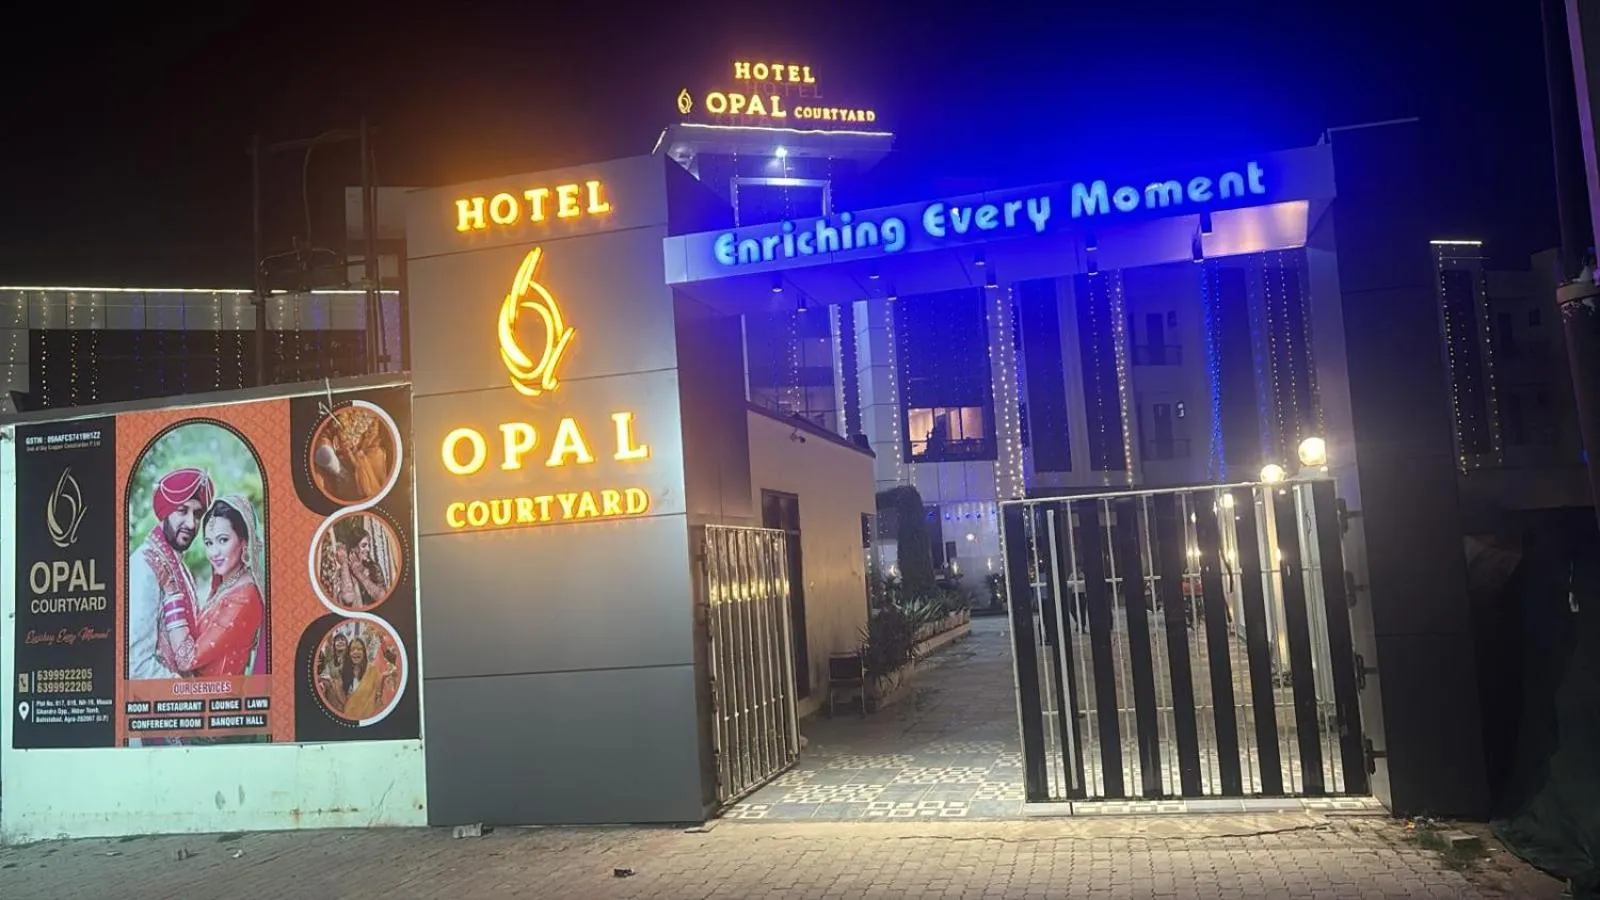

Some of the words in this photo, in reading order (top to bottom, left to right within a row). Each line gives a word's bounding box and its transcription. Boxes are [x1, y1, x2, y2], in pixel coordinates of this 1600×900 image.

[734, 62, 815, 83] HOTEL
[706, 92, 786, 118] OPAL
[794, 106, 876, 122] COURTYARD
[456, 180, 610, 232] HOTEL
[713, 212, 906, 266] Enriching
[923, 196, 1051, 233] Every
[1070, 161, 1266, 218] Moment
[442, 411, 649, 476] OPAL
[446, 487, 649, 529] COURTYARD
[30, 559, 106, 594] OPAL
[31, 597, 107, 613] COURTYARD
[37, 668, 93, 680] 6399922205
[37, 681, 93, 693] 6399922206
[173, 682, 191, 695] OUR
[192, 681, 232, 695] SERVICES
[127, 703, 149, 713] ROOM
[157, 702, 203, 712] RESTAURANT
[211, 700, 239, 710] LOUNGE
[247, 698, 268, 709] LAWN
[131, 719, 178, 729] CONFERENCE
[179, 718, 202, 728] ROOM
[211, 716, 244, 727] BANQUET
[245, 715, 264, 725] HALL
